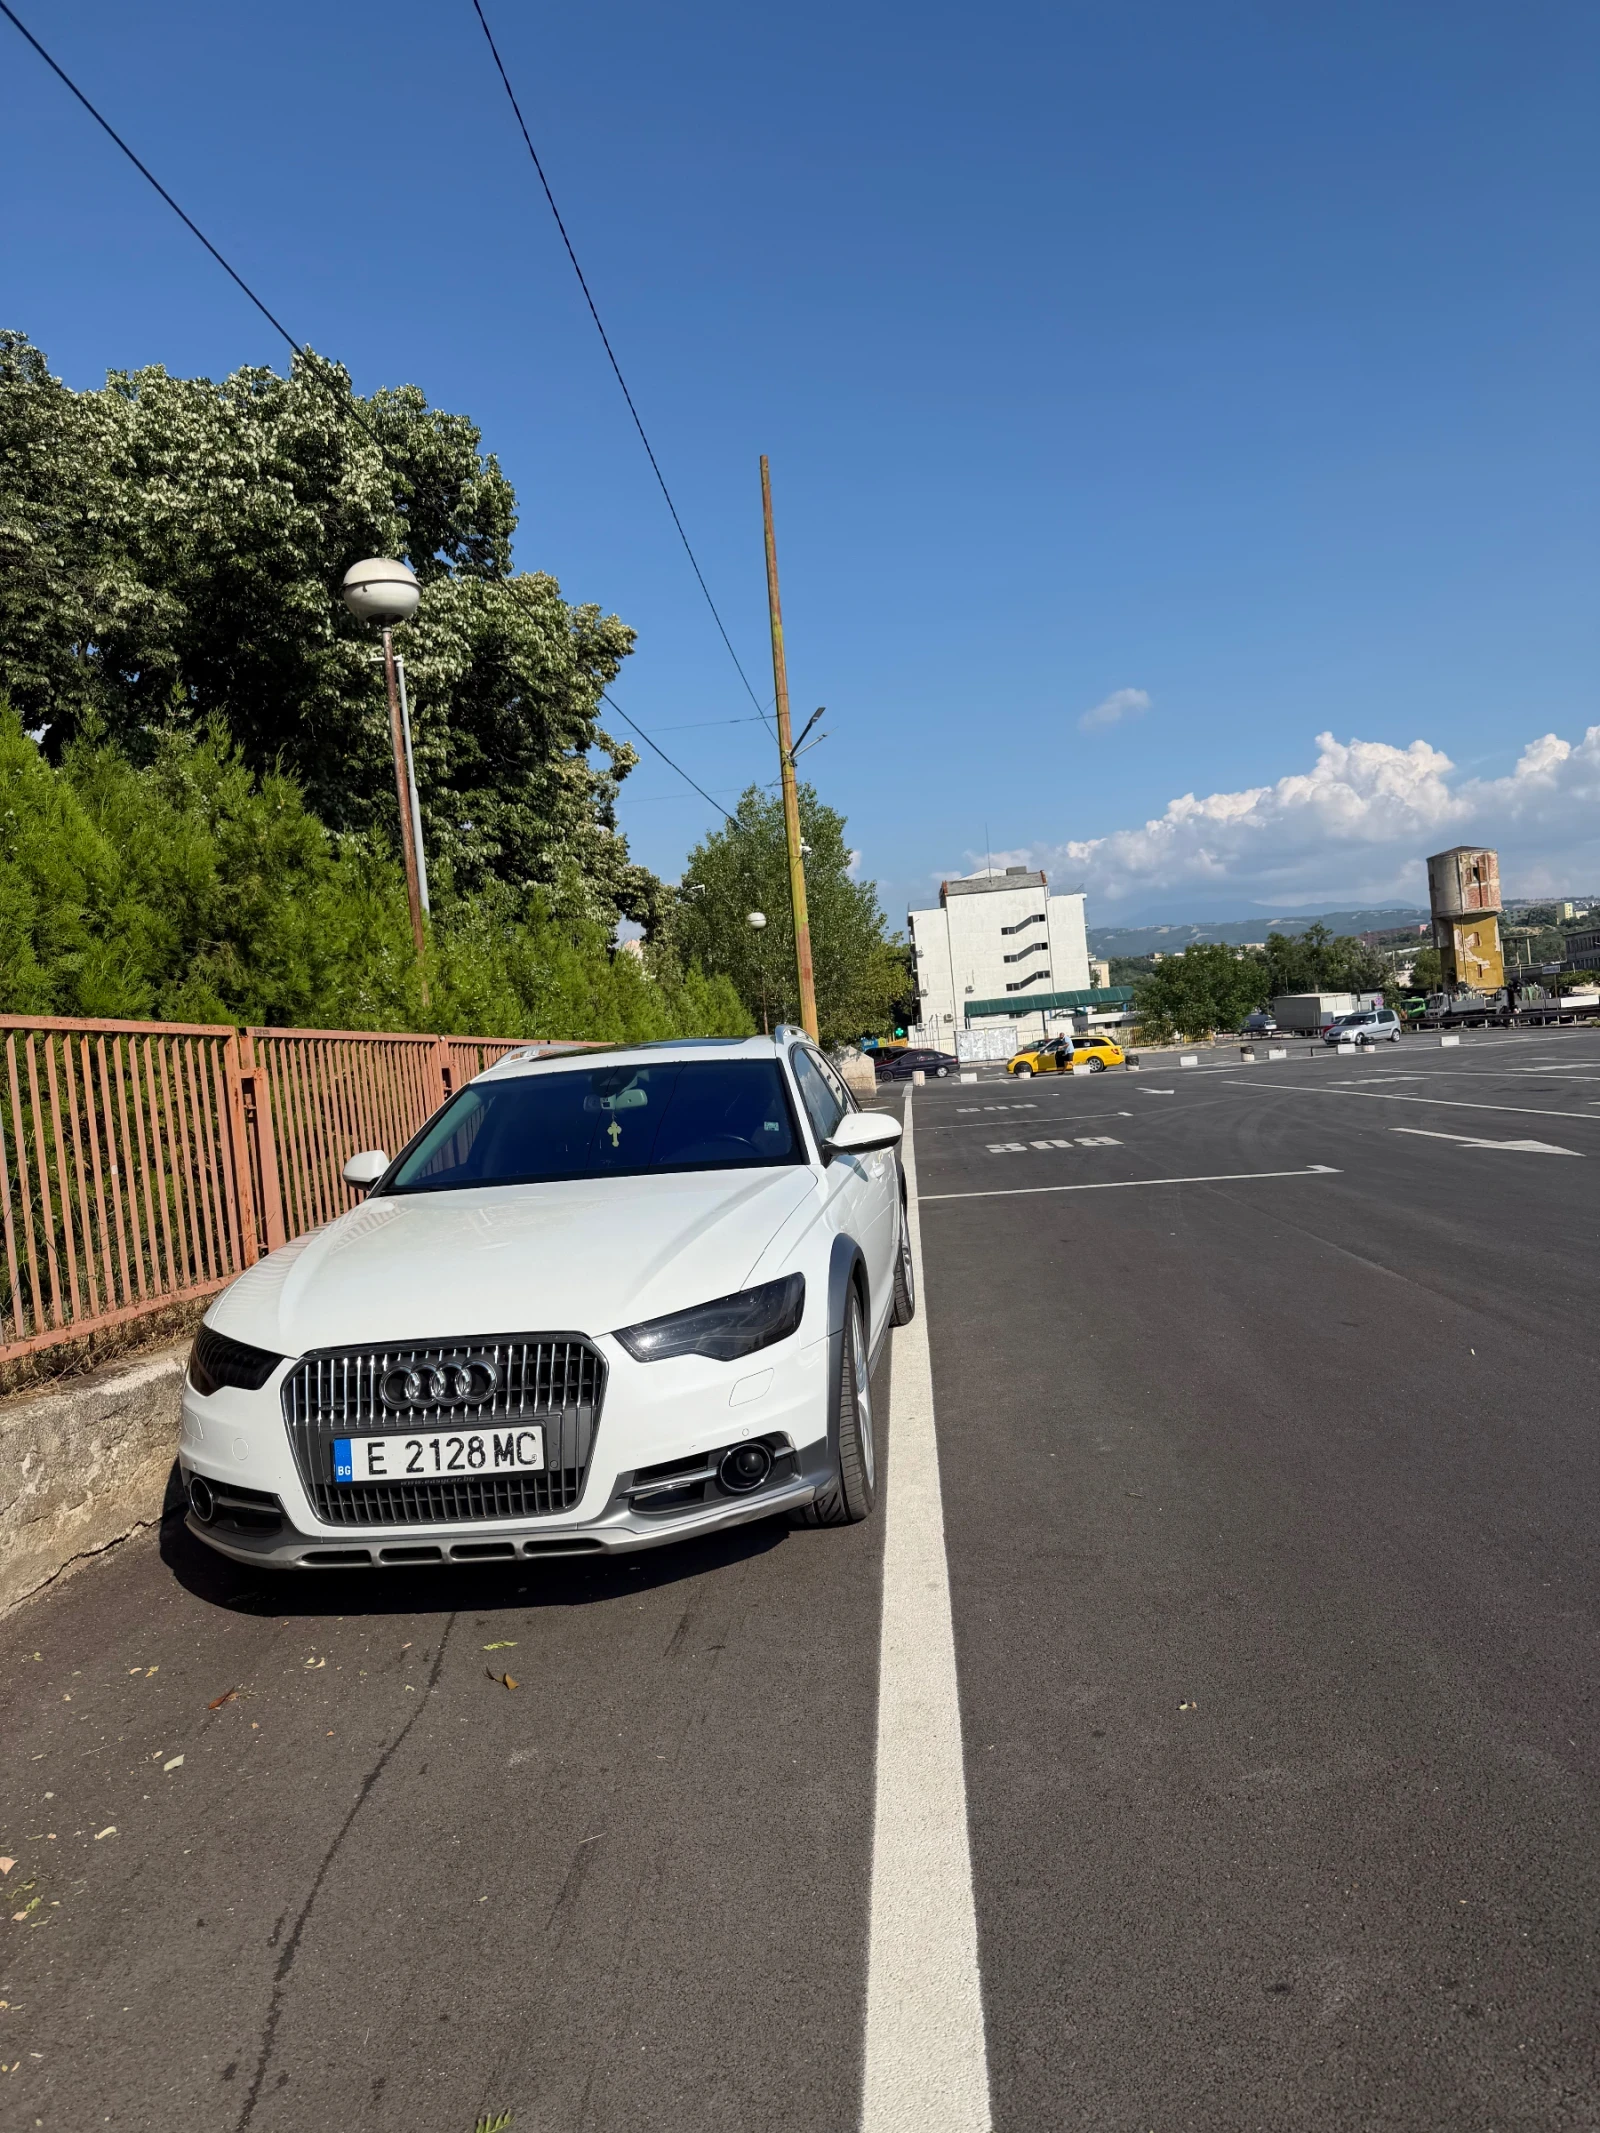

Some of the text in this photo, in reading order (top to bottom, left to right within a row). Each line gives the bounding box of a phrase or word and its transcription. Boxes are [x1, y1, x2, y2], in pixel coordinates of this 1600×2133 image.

[985, 1136, 1124, 1153] BUS
[367, 1431, 538, 1475] E 2128 MC
[338, 1465, 351, 1476] BG
